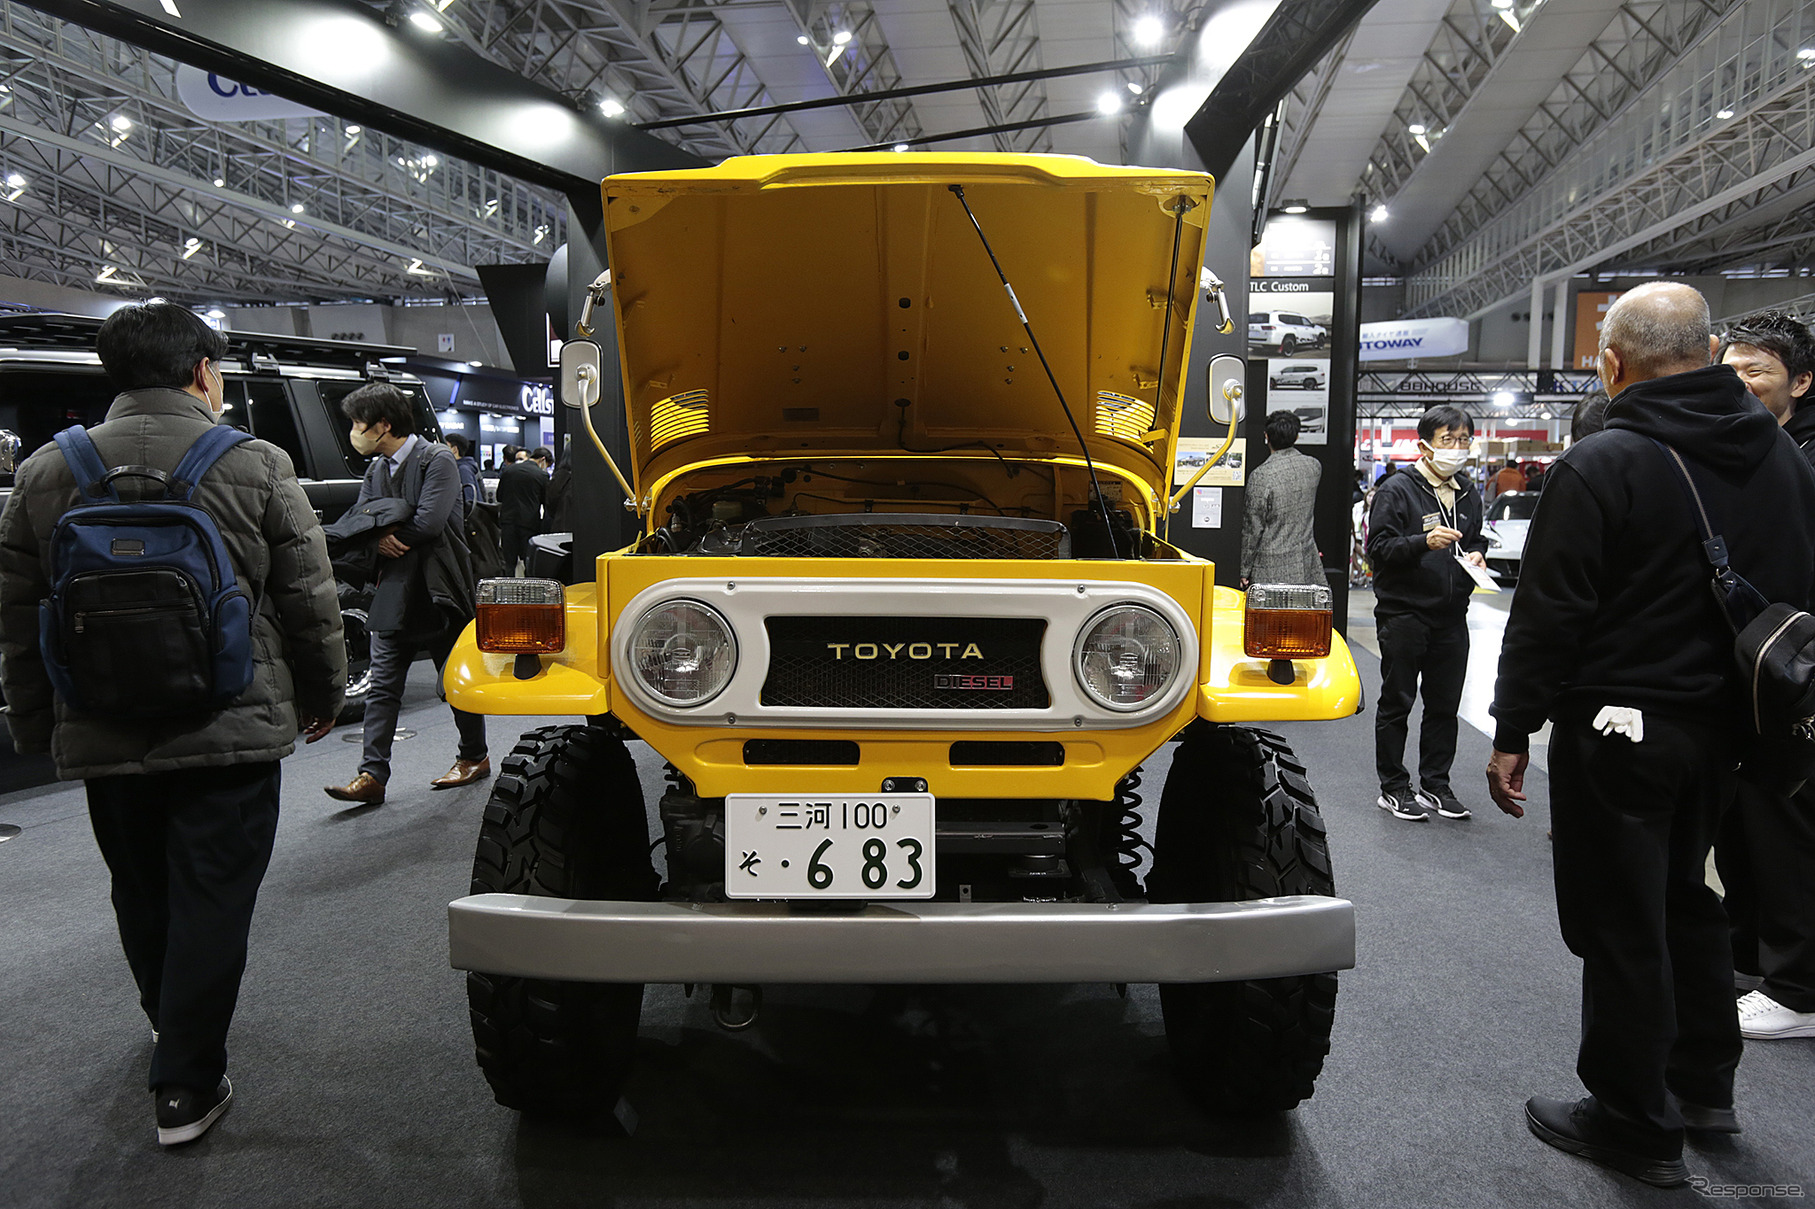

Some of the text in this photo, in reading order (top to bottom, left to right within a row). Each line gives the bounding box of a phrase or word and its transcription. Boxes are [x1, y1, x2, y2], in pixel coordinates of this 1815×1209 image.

[1271, 281, 1309, 292] Custom
[1359, 337, 1423, 350] TOWAY
[827, 642, 984, 660] TOYOTA
[936, 676, 1012, 689] DIESEL
[739, 850, 761, 877] そ
